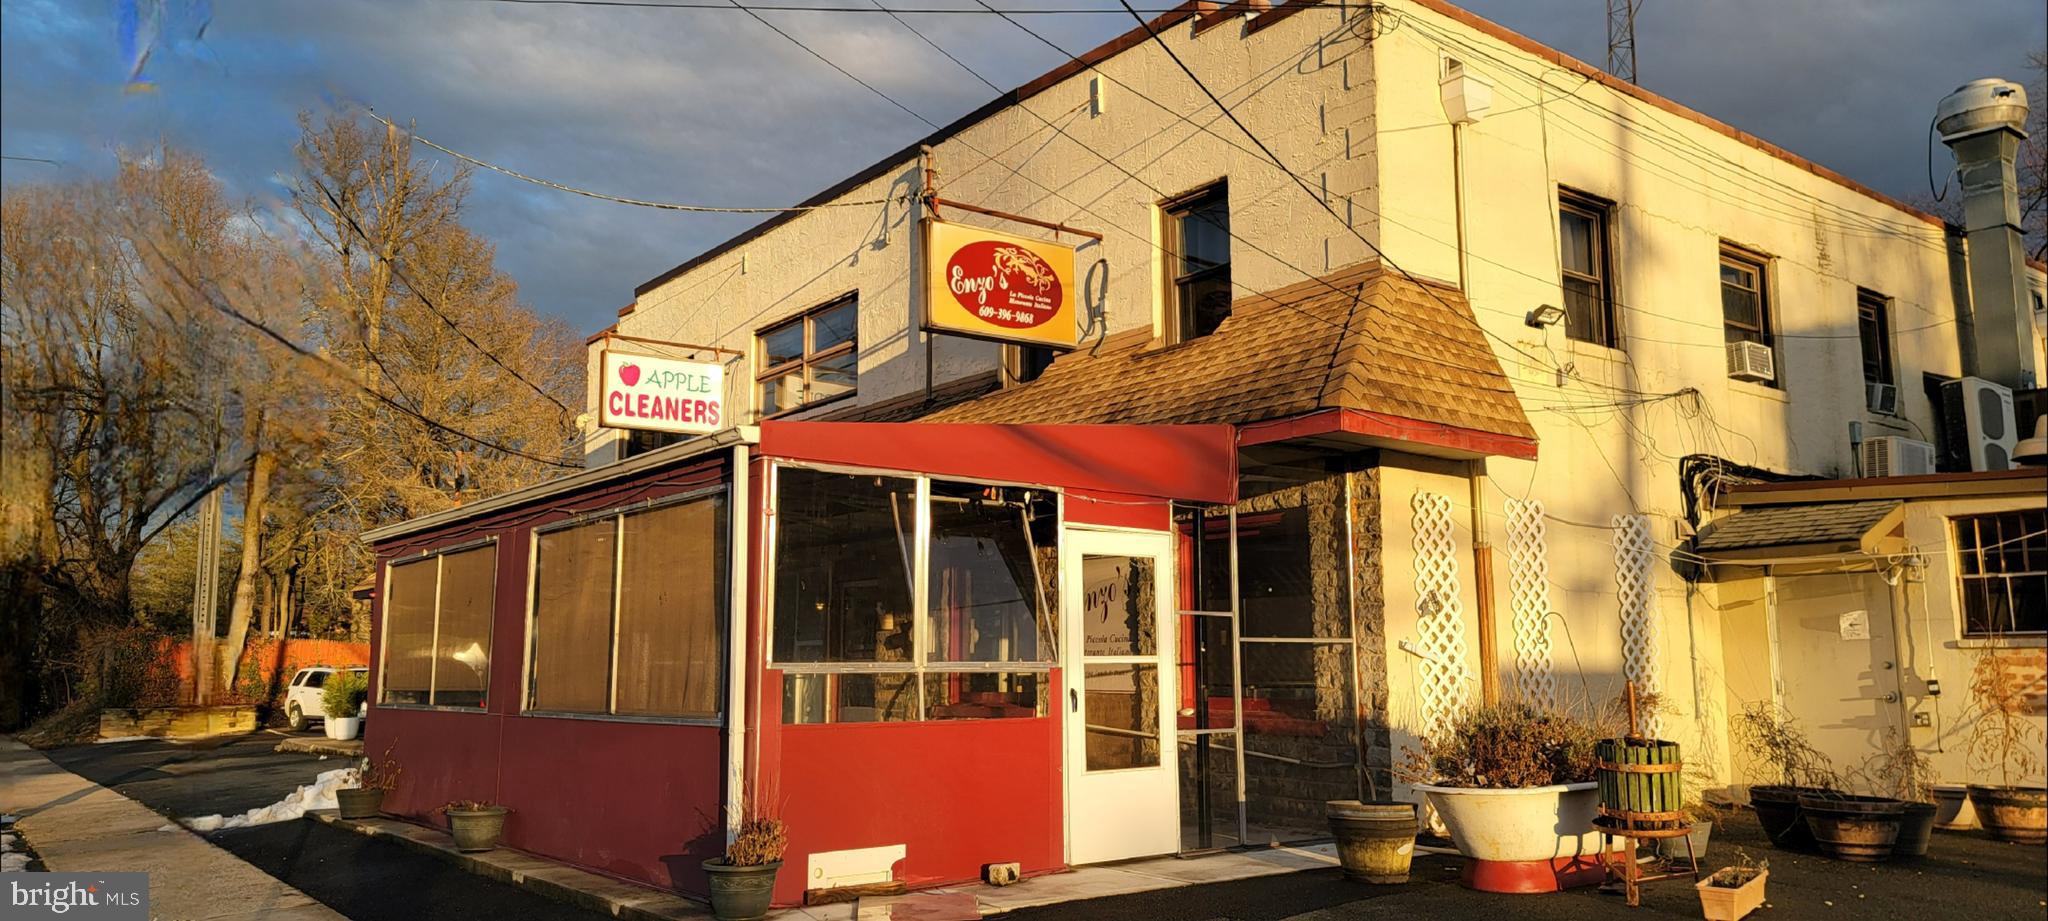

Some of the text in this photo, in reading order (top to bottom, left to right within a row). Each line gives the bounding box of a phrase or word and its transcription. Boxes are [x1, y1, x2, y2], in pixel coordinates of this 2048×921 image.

[951, 264, 1009, 304] Enzo's
[978, 306, 1034, 324] 609-396-9868
[645, 369, 711, 393] APPLE
[609, 390, 720, 425] CLEANERS
